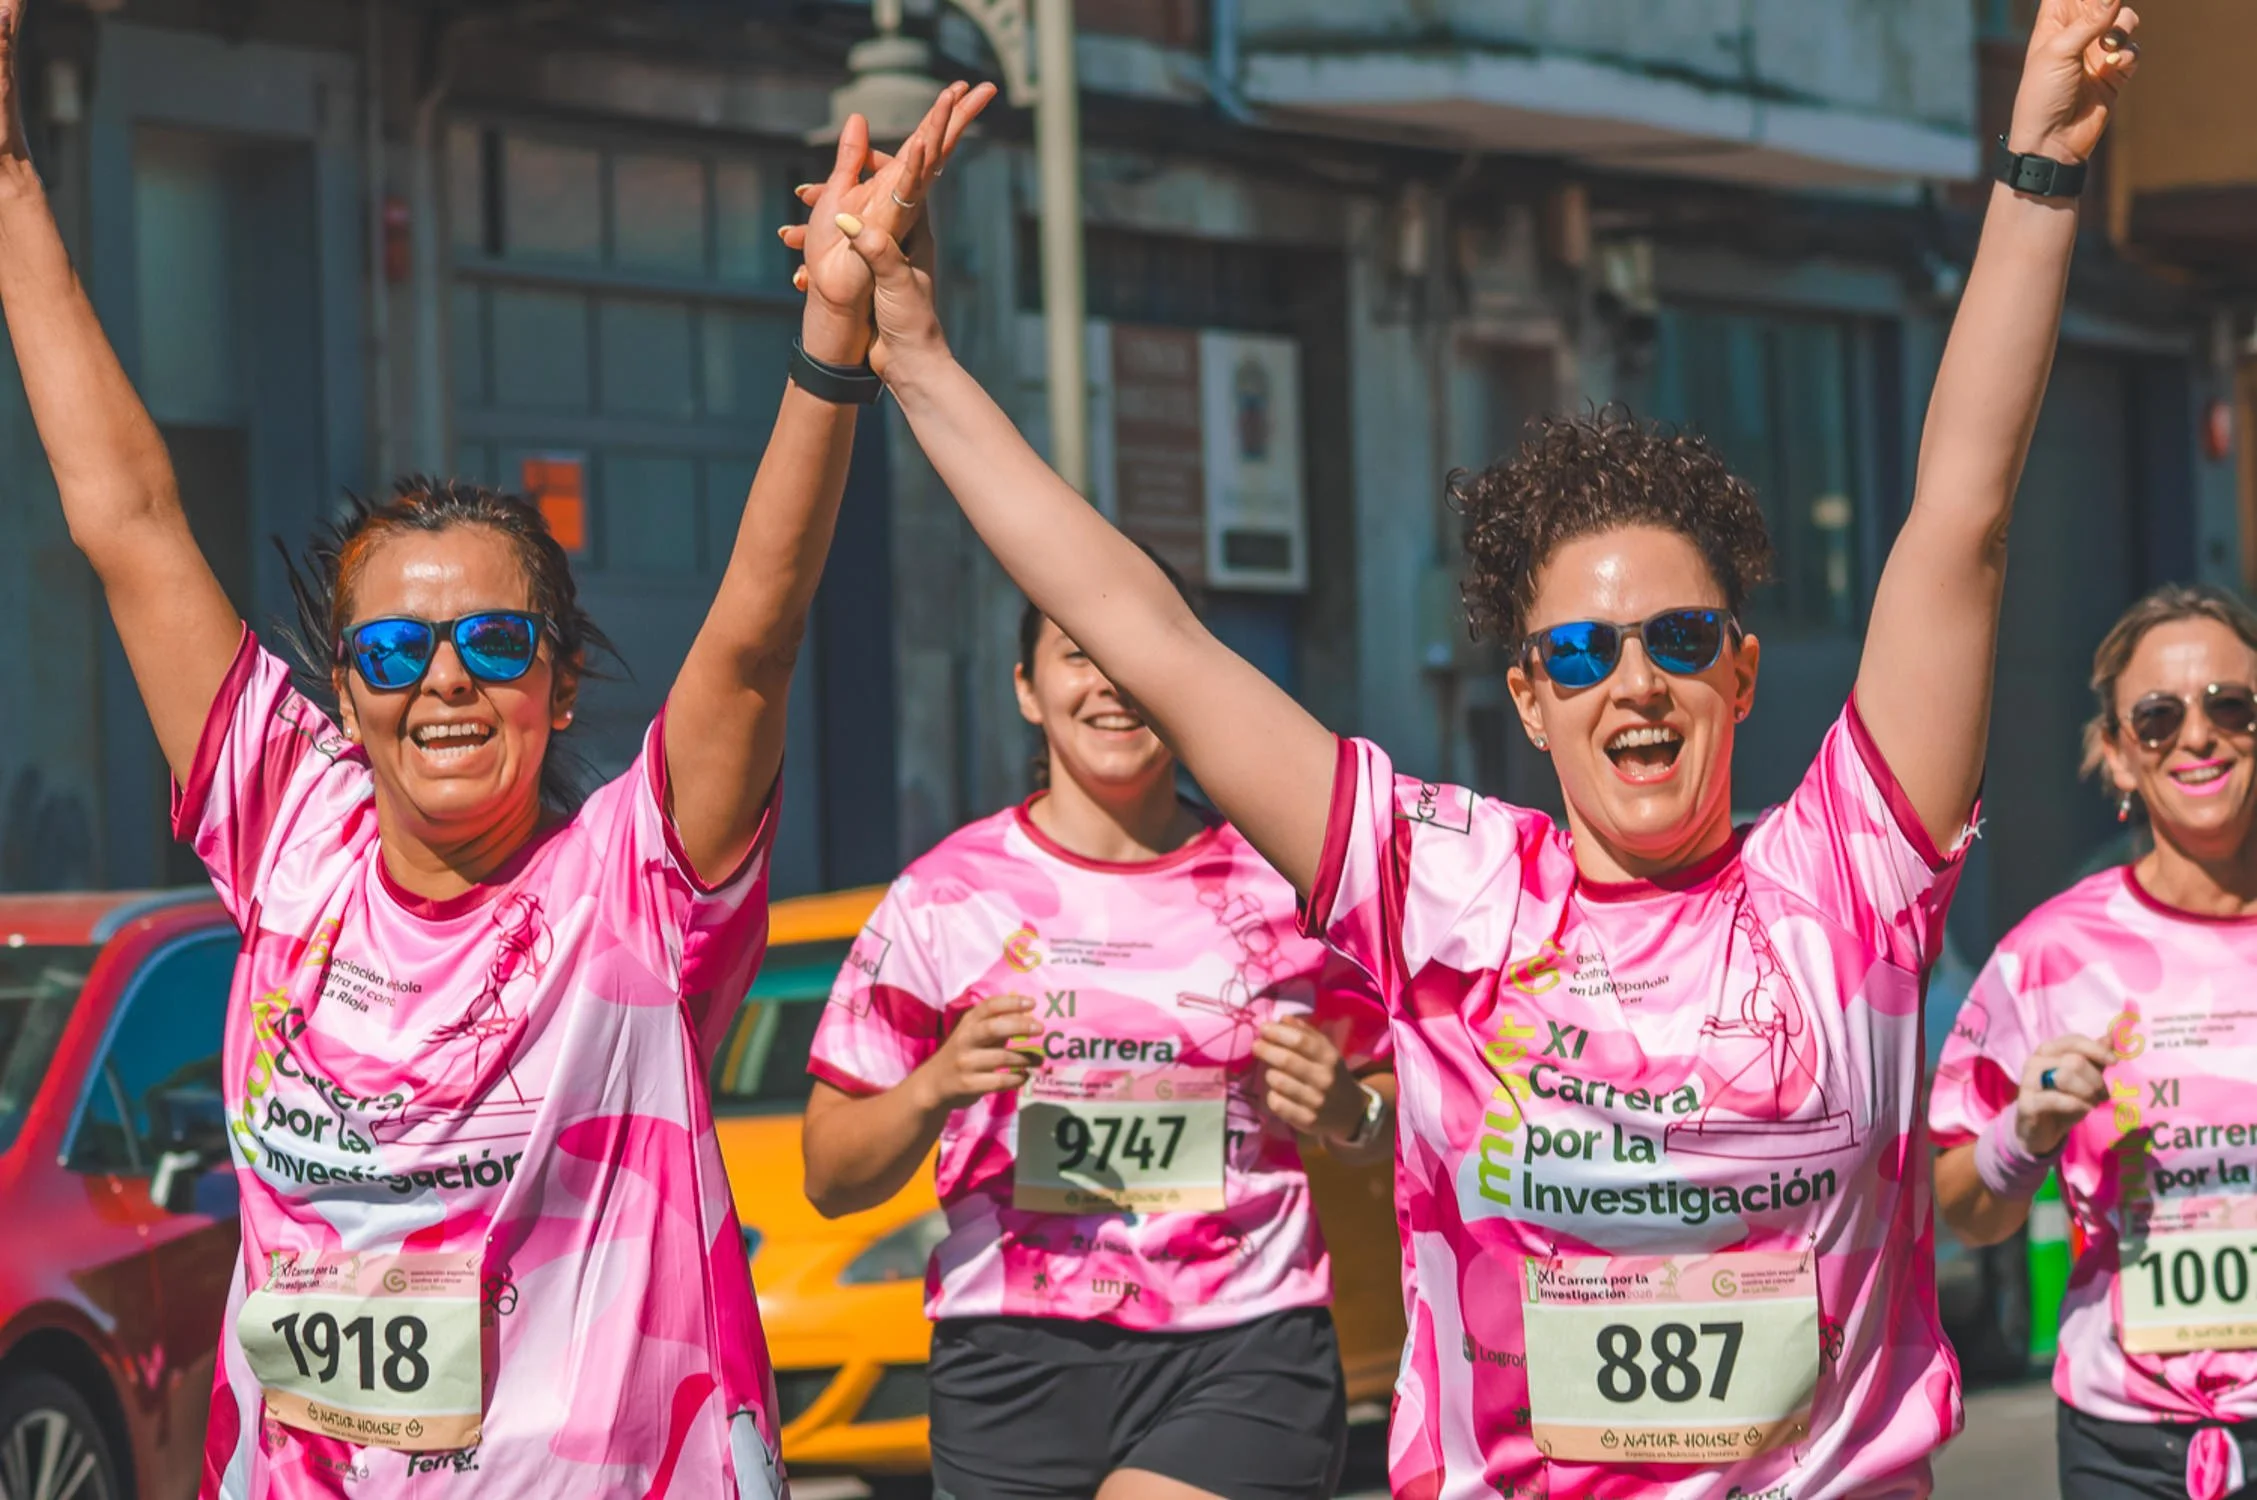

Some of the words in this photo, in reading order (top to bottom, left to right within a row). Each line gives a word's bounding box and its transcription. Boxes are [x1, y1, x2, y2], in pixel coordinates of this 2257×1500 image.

[1616, 975, 1670, 994] spañola
[337, 991, 370, 1013] Rioja
[1045, 990, 1076, 1019] XI
[1043, 1031, 1175, 1063] Carrera
[1541, 1020, 1589, 1060] XI
[1528, 1062, 1700, 1114] Carrera
[2148, 1078, 2180, 1109] XI
[261, 1096, 333, 1142] por
[338, 1115, 372, 1155] la
[2150, 1121, 2257, 1151] Carrer
[1055, 1115, 1187, 1173] 9747
[1524, 1123, 1602, 1165] por
[1612, 1122, 1656, 1165] la
[2154, 1165, 2211, 1197] por
[2218, 1157, 2251, 1185] la
[1523, 1166, 1837, 1226] Investigación
[1538, 1270, 1556, 1285] XI
[1558, 1275, 1608, 1286] Carrera
[1610, 1274, 1633, 1290] por
[1635, 1273, 1650, 1285] la
[2139, 1245, 2257, 1308] 100
[1539, 1287, 1626, 1302] Investigación
[271, 1311, 430, 1394] 1918
[1480, 1344, 1526, 1369] Logro
[1596, 1320, 1744, 1403] 887
[320, 1408, 356, 1428] NATUR
[357, 1418, 402, 1436] HOUSE
[1623, 1432, 1680, 1448] NATUR
[1683, 1431, 1741, 1448] HOUSE
[407, 1449, 477, 1478] Ferrer
